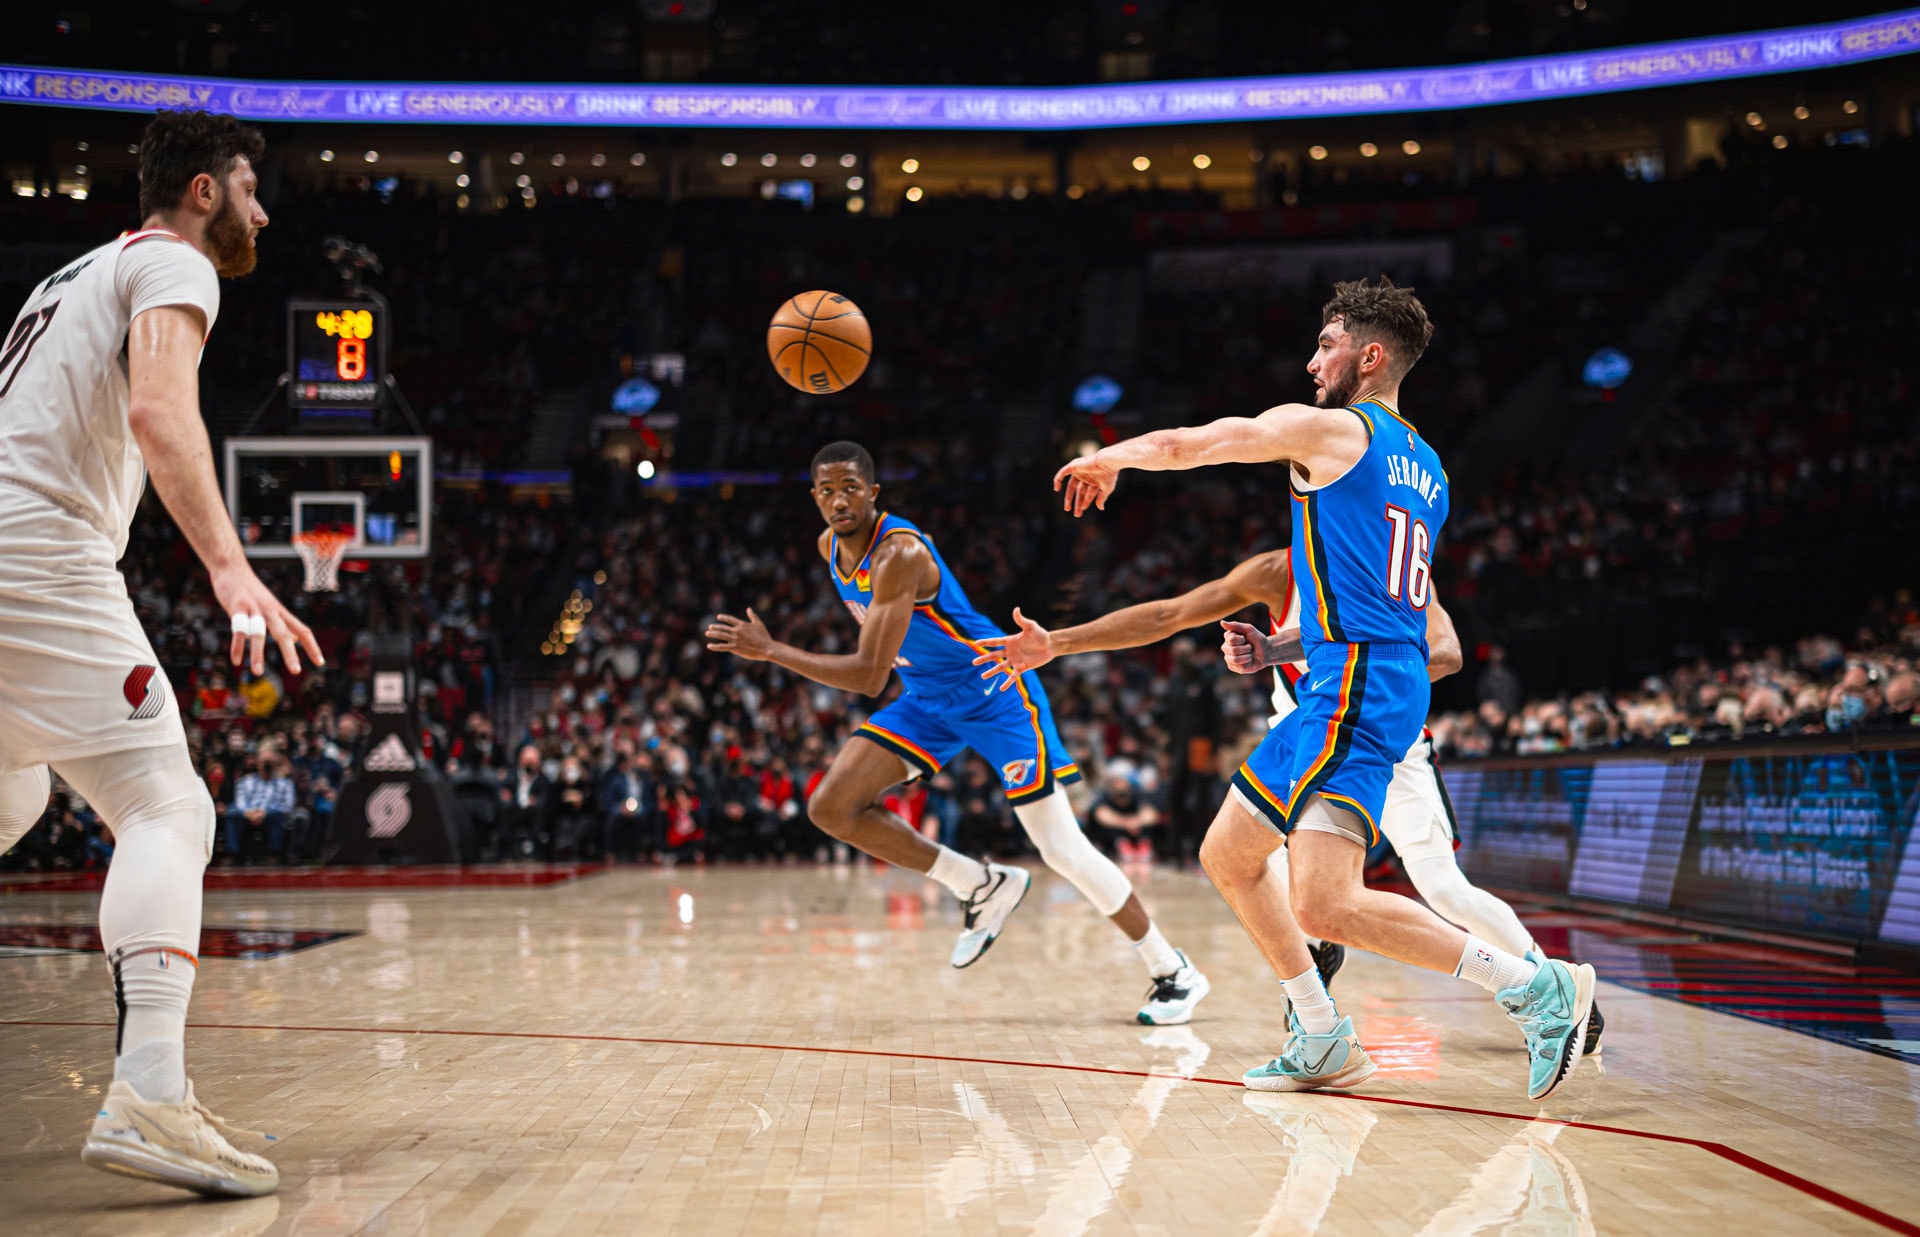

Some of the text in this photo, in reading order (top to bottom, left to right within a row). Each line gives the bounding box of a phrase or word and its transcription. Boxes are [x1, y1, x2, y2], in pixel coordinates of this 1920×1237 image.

[345, 90, 402, 114] LIVE
[337, 337, 367, 381] 8
[319, 382, 377, 401] TISSOT
[1386, 454, 1441, 508] JEROME
[1384, 502, 1432, 612] 16
